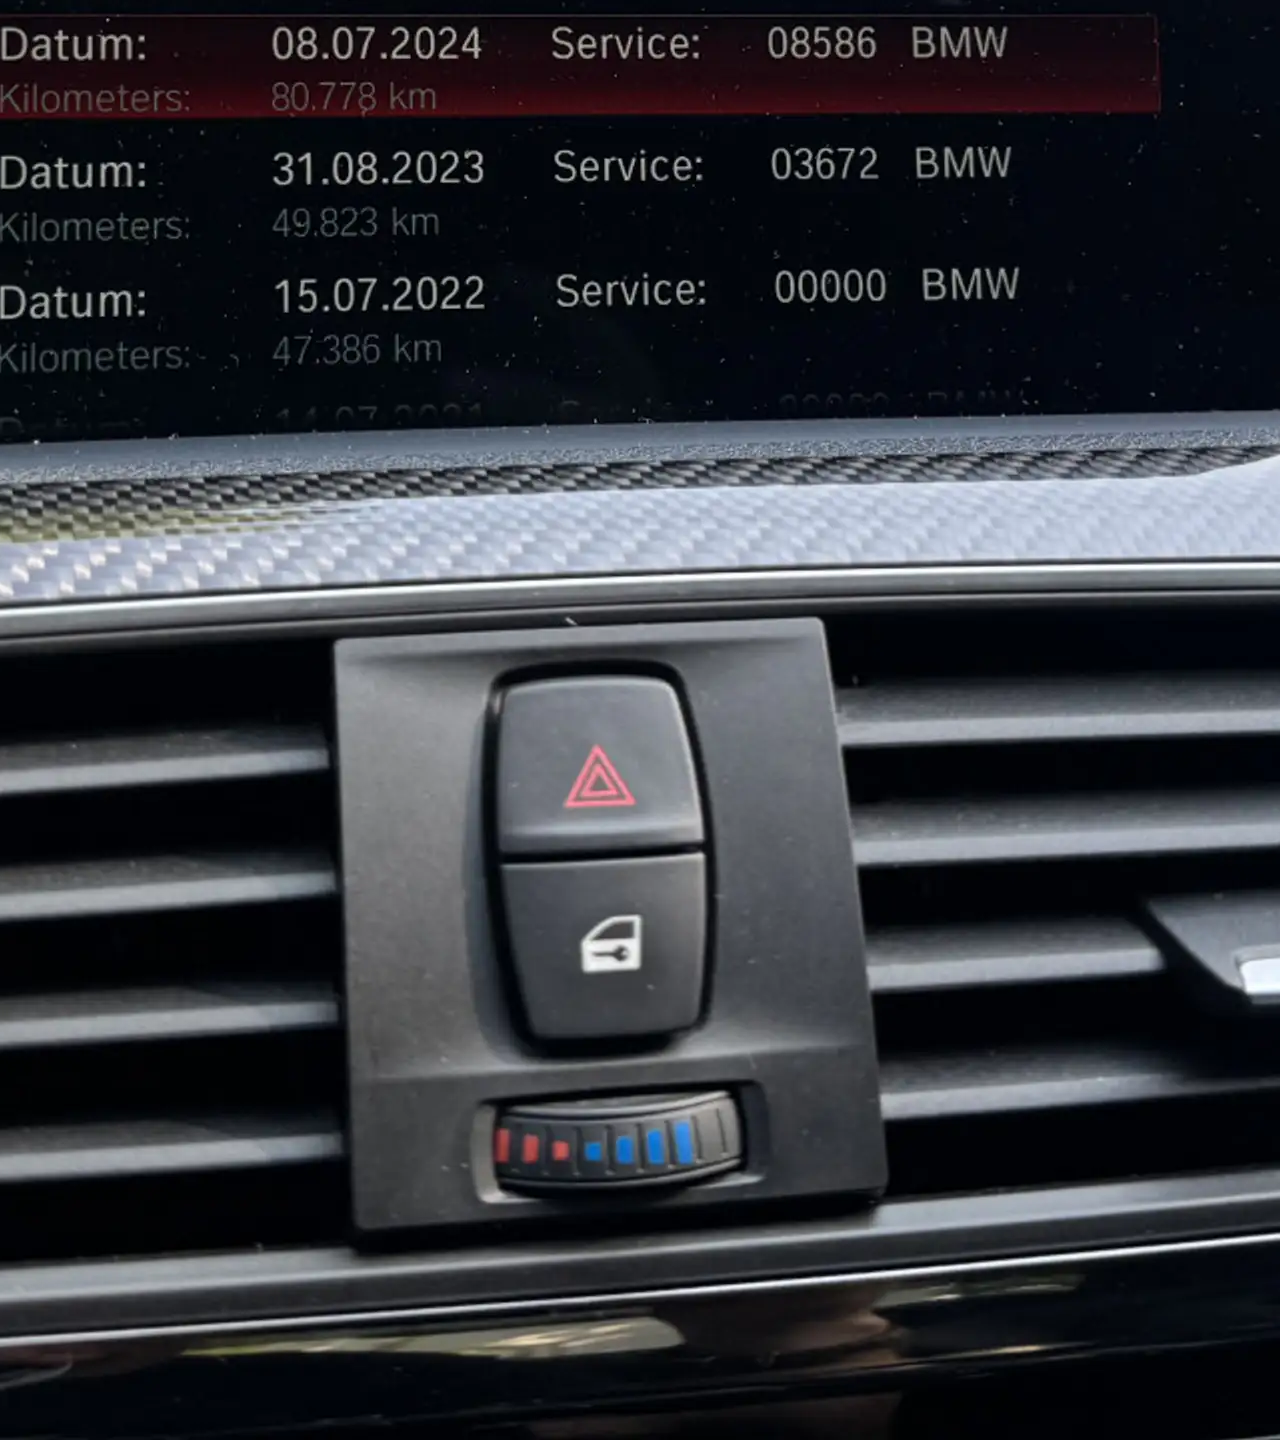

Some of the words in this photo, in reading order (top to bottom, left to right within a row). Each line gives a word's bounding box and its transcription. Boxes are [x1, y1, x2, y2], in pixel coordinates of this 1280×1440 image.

[0, 26, 146, 61] Datum:
[272, 26, 482, 60] 08.07.2024
[551, 26, 700, 60] Service:
[767, 25, 877, 59] 08586
[912, 26, 1008, 59] BMW
[0, 83, 190, 114] Kilometers:
[271, 81, 377, 112] 80.778
[389, 81, 437, 110] km
[0, 155, 146, 190] Datum:
[273, 150, 484, 186] 31.08.2023
[554, 149, 703, 183] Service:
[771, 146, 879, 180] 03672
[915, 146, 1012, 179] BMW
[272, 206, 378, 238] 49.823
[392, 206, 439, 236] km
[275, 275, 485, 314] 15.07.2022
[556, 272, 706, 308] Service:
[775, 268, 887, 304] 00000
[922, 267, 1020, 301] BMW
[272, 333, 381, 366] 47.386
[394, 333, 442, 363] km
